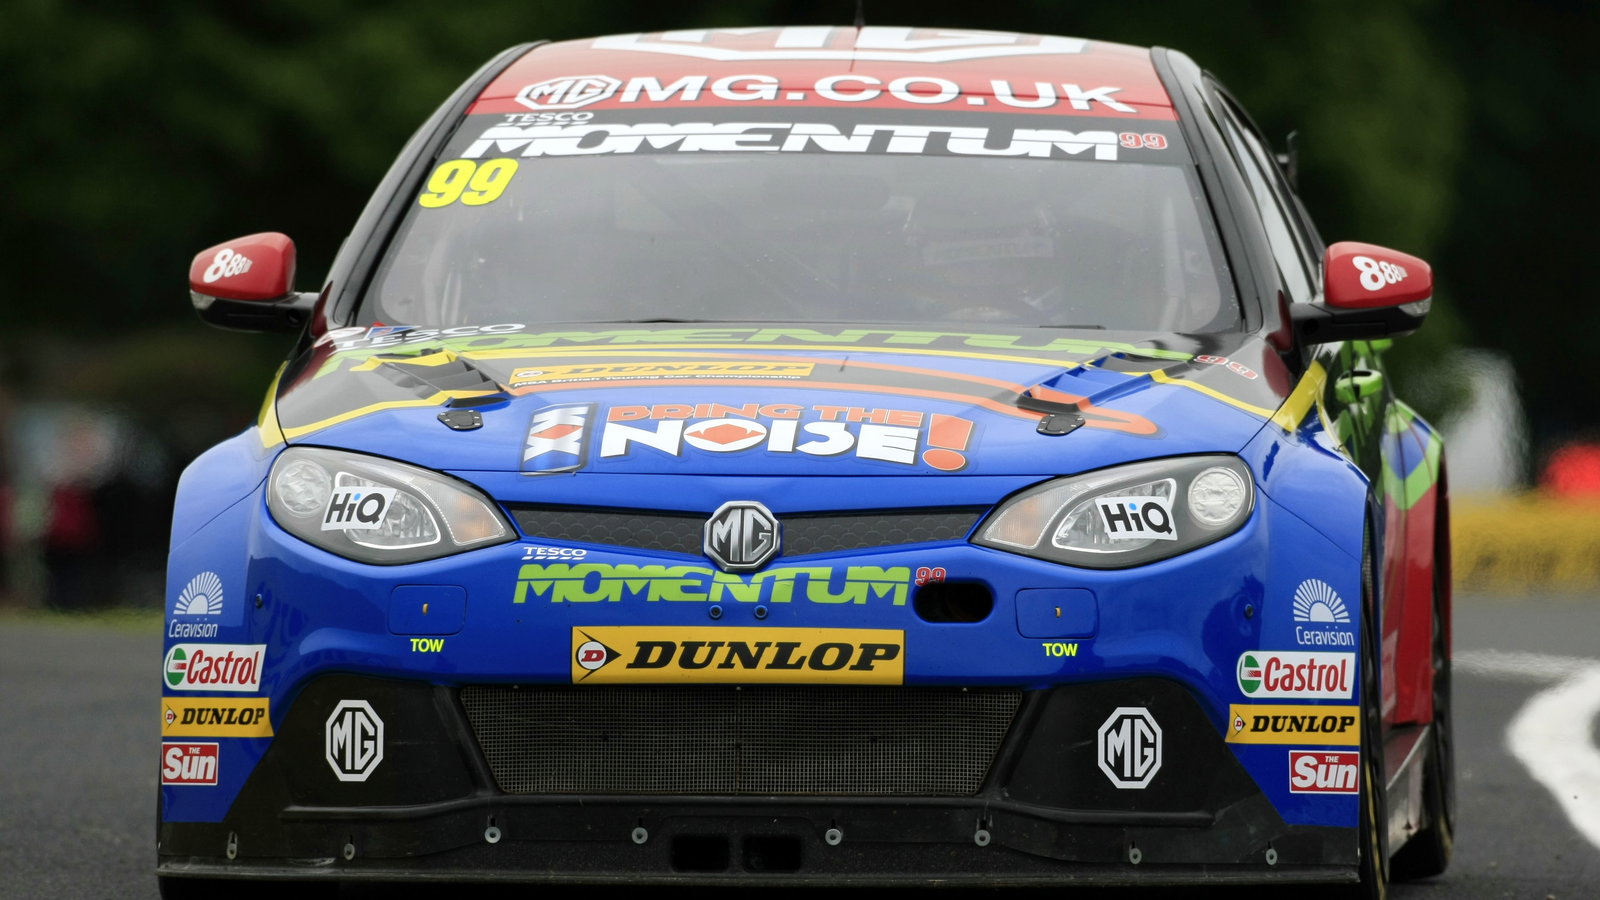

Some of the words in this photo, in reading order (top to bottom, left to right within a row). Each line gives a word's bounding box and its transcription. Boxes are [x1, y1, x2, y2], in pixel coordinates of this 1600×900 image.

[525, 78, 610, 104] MG
[619, 74, 1137, 113] MG.CO.UK
[504, 111, 595, 122] TESCO
[461, 122, 1118, 161] MOMENTUM
[1119, 132, 1169, 150] 99
[418, 158, 519, 208] 99
[329, 323, 526, 349] TESCO
[562, 364, 811, 375] DUNLOP
[812, 406, 924, 427] THE
[325, 492, 386, 525] HiQ
[1101, 501, 1173, 535] HiQ
[711, 507, 773, 563] MG
[523, 546, 587, 557] TESCO
[513, 563, 911, 606] MOMENTUM
[915, 566, 946, 587] 99
[168, 617, 219, 638] Ceravision
[1295, 625, 1355, 646] Ceravision
[410, 638, 445, 653] TOW
[625, 640, 901, 671] DUNLOP
[1042, 642, 1078, 657] TOW
[186, 649, 260, 685] Castrol
[1264, 656, 1348, 692] Castrol
[180, 707, 266, 726] DUNLOP
[1250, 715, 1356, 733] DUNLOP
[188, 746, 201, 755] THE
[332, 711, 376, 771] MG
[1107, 718, 1155, 778] MG
[163, 747, 217, 781] Sun
[1291, 755, 1358, 789] Sun
[1324, 755, 1340, 764] THE
